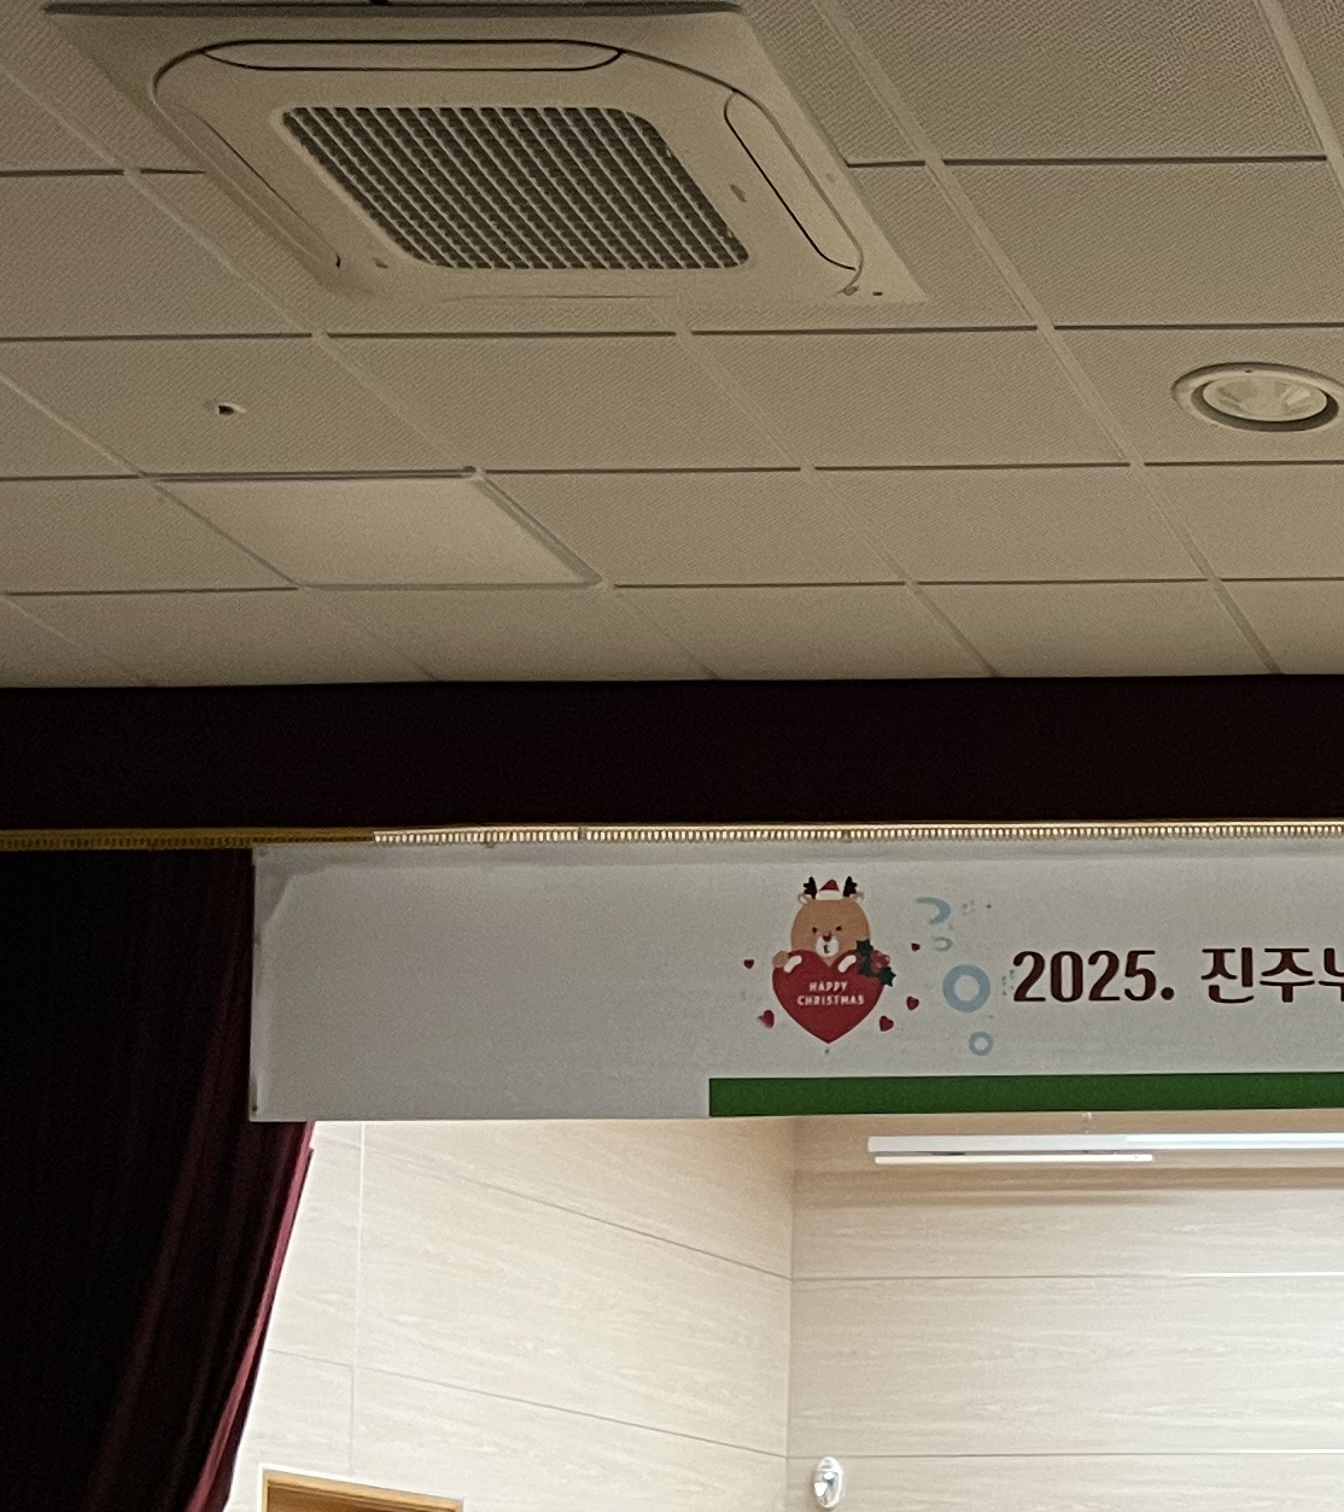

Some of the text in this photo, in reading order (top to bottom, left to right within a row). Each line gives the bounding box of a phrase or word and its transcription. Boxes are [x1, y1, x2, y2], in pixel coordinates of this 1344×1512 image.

[1012, 950, 1175, 1002] 2025.
[808, 980, 849, 993] HAPPY
[796, 994, 865, 1006] CHRISTMAS
